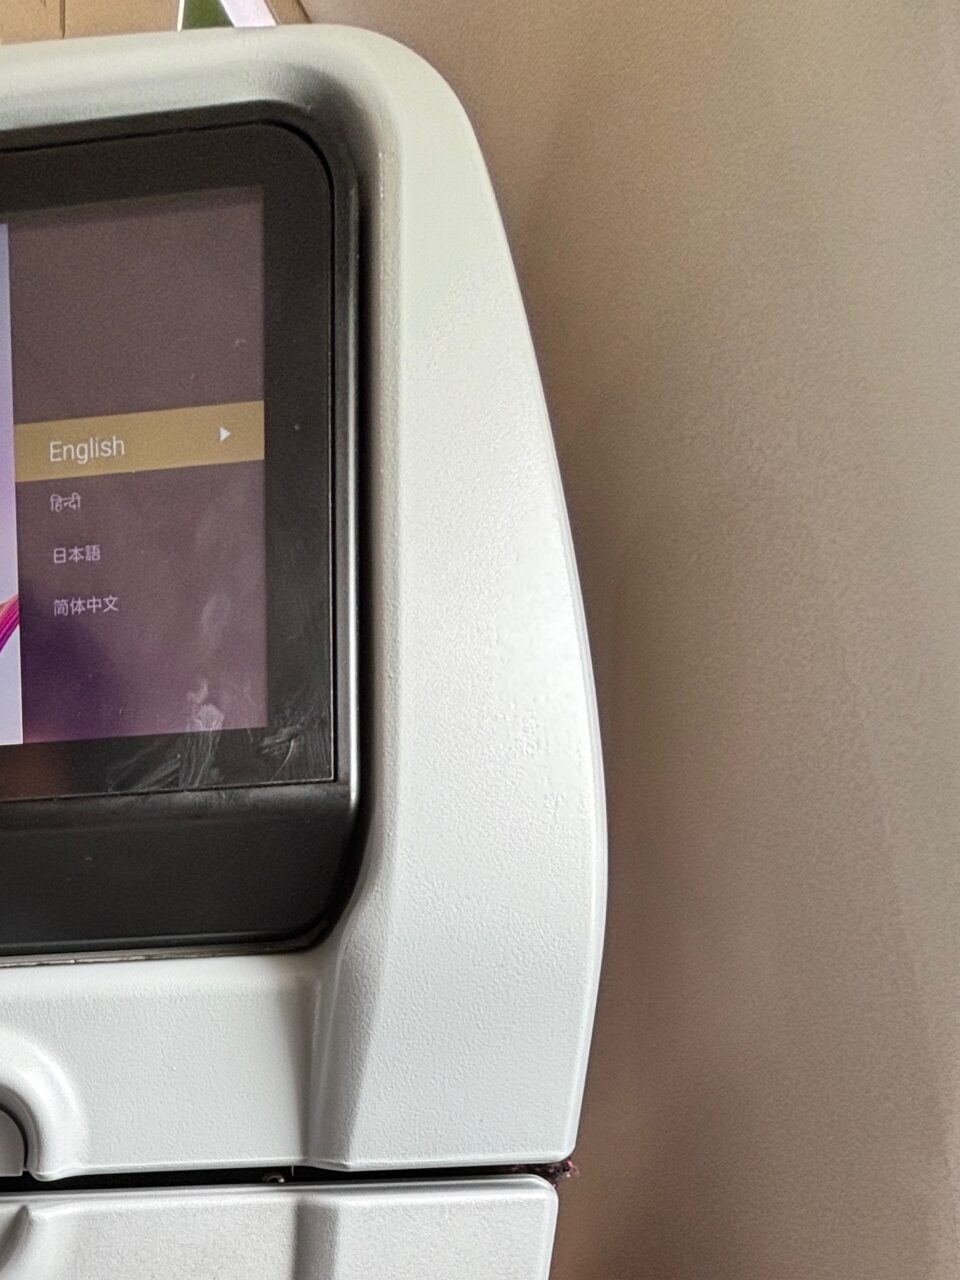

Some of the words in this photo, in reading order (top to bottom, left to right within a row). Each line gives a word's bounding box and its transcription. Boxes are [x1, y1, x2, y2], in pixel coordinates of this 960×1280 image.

[49, 436, 125, 464] English
[50, 492, 82, 513] हिन्दी
[53, 544, 101, 564] 日本語
[53, 594, 120, 617] 简体中文
